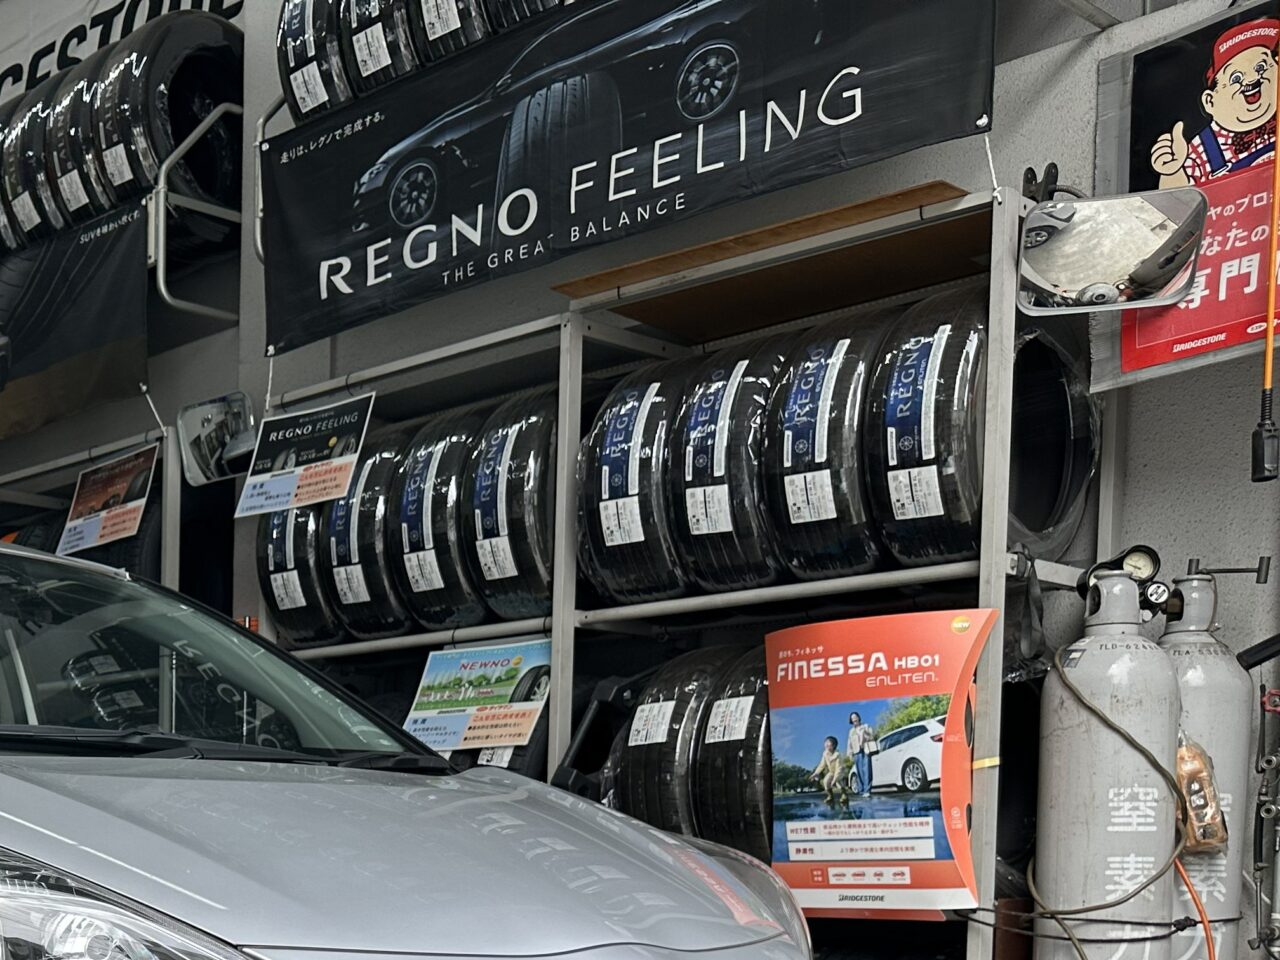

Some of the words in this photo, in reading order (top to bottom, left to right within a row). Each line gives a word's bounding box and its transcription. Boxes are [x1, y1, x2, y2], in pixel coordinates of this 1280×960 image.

[1219, 27, 1279, 53] BRIDGESTONE
[318, 187, 539, 300] REGNO
[570, 66, 864, 213] FEELING
[441, 261, 475, 285] THE
[570, 193, 687, 242] BALANCE
[1172, 333, 1227, 353] BRIDGESTONE
[897, 337, 923, 418] REGNO
[269, 424, 312, 442] REGNO
[315, 411, 358, 431] FEELING
[460, 658, 510, 671] NEWNO
[777, 651, 888, 683] FINESSA
[894, 654, 940, 670] HB01
[838, 894, 885, 902] BRIDGESTONE
